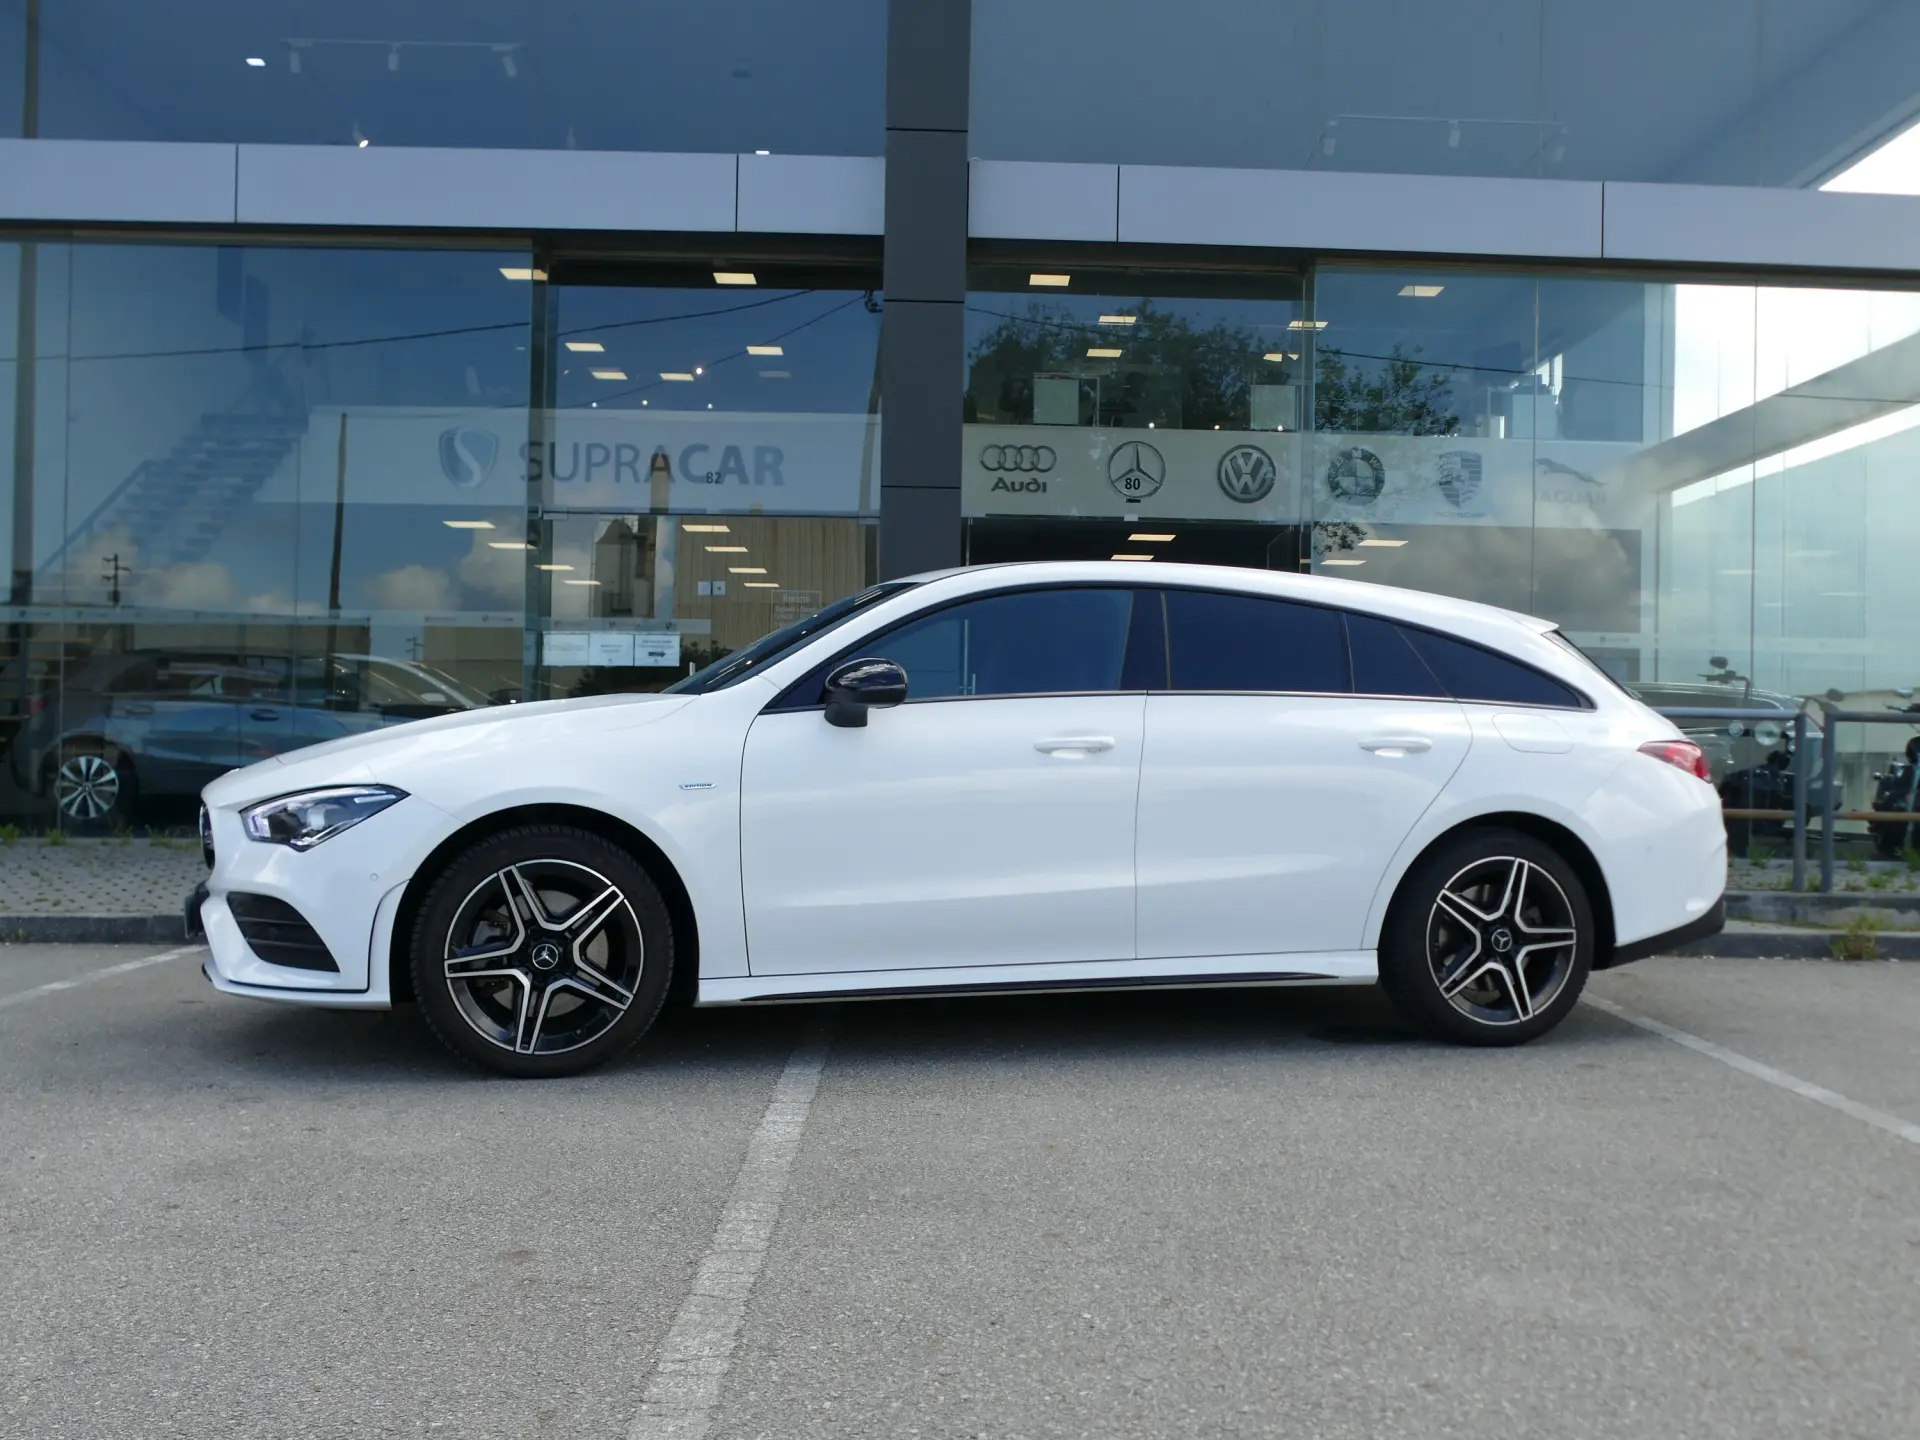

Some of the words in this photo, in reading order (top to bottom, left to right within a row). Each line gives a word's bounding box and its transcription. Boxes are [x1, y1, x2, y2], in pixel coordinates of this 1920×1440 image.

[519, 441, 785, 486] SUPRACAR
[705, 471, 723, 485] 82
[990, 476, 1047, 493] Audi
[1124, 477, 1141, 491] 80
